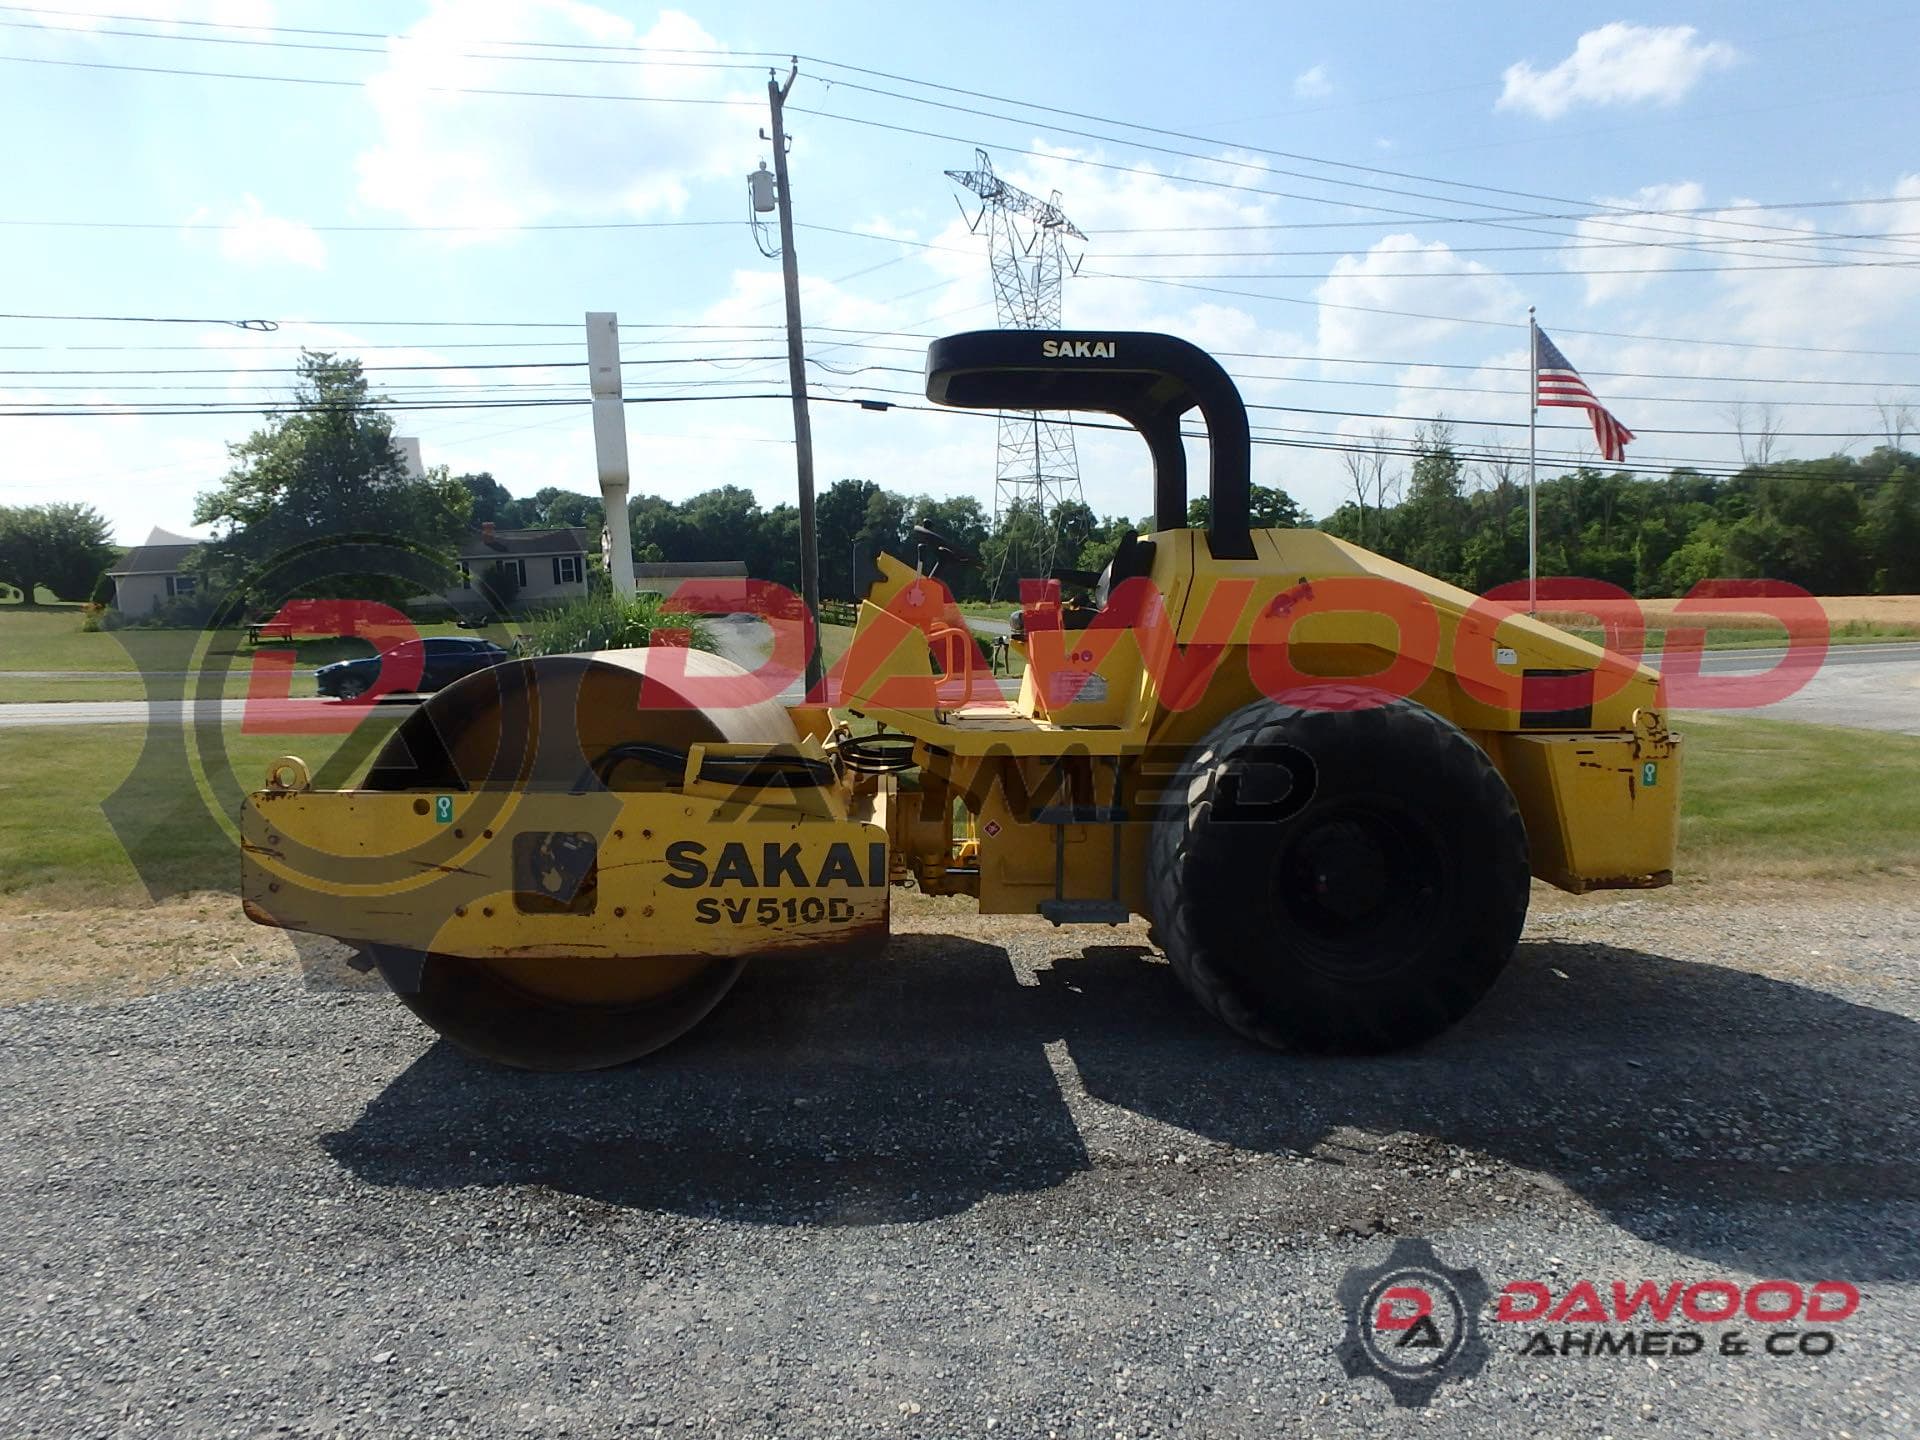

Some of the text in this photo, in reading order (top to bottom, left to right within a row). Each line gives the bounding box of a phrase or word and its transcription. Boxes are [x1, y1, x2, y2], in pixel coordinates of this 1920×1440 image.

[1043, 340, 1116, 358] SAKAI
[662, 840, 886, 889] SAKAI
[695, 897, 855, 925] SV510D
